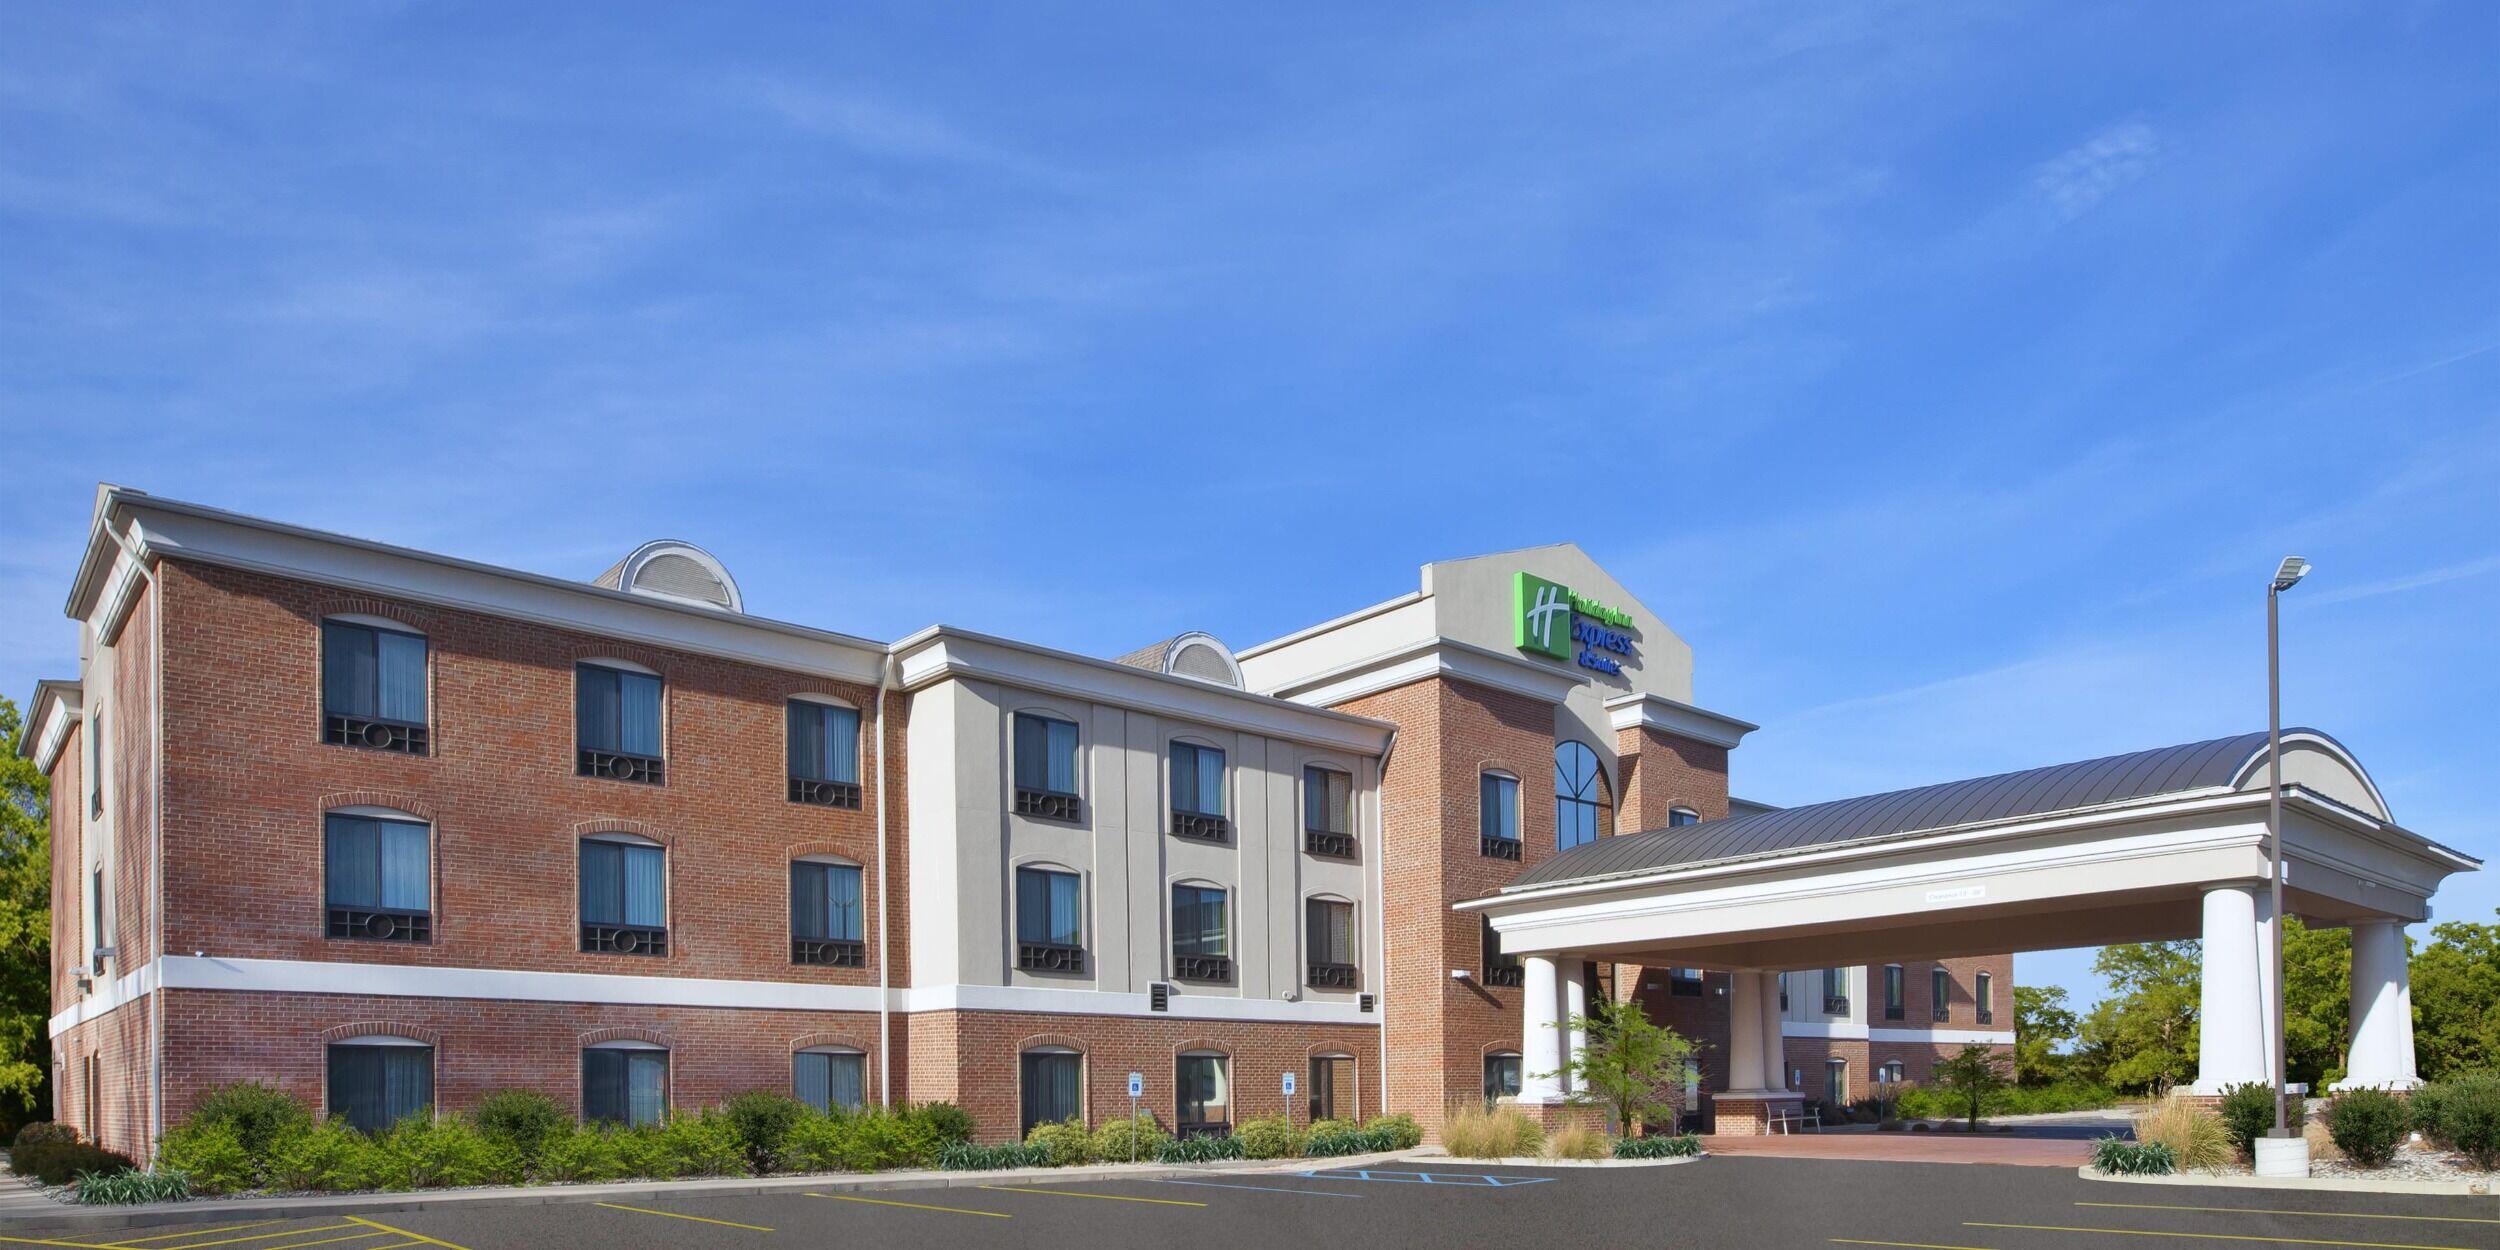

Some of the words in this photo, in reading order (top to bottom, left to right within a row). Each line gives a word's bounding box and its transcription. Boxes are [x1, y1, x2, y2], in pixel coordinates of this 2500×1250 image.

[1569, 589, 1614, 626] Holiday
[1614, 606, 1633, 628] Inn
[1571, 614, 1633, 656] Express
